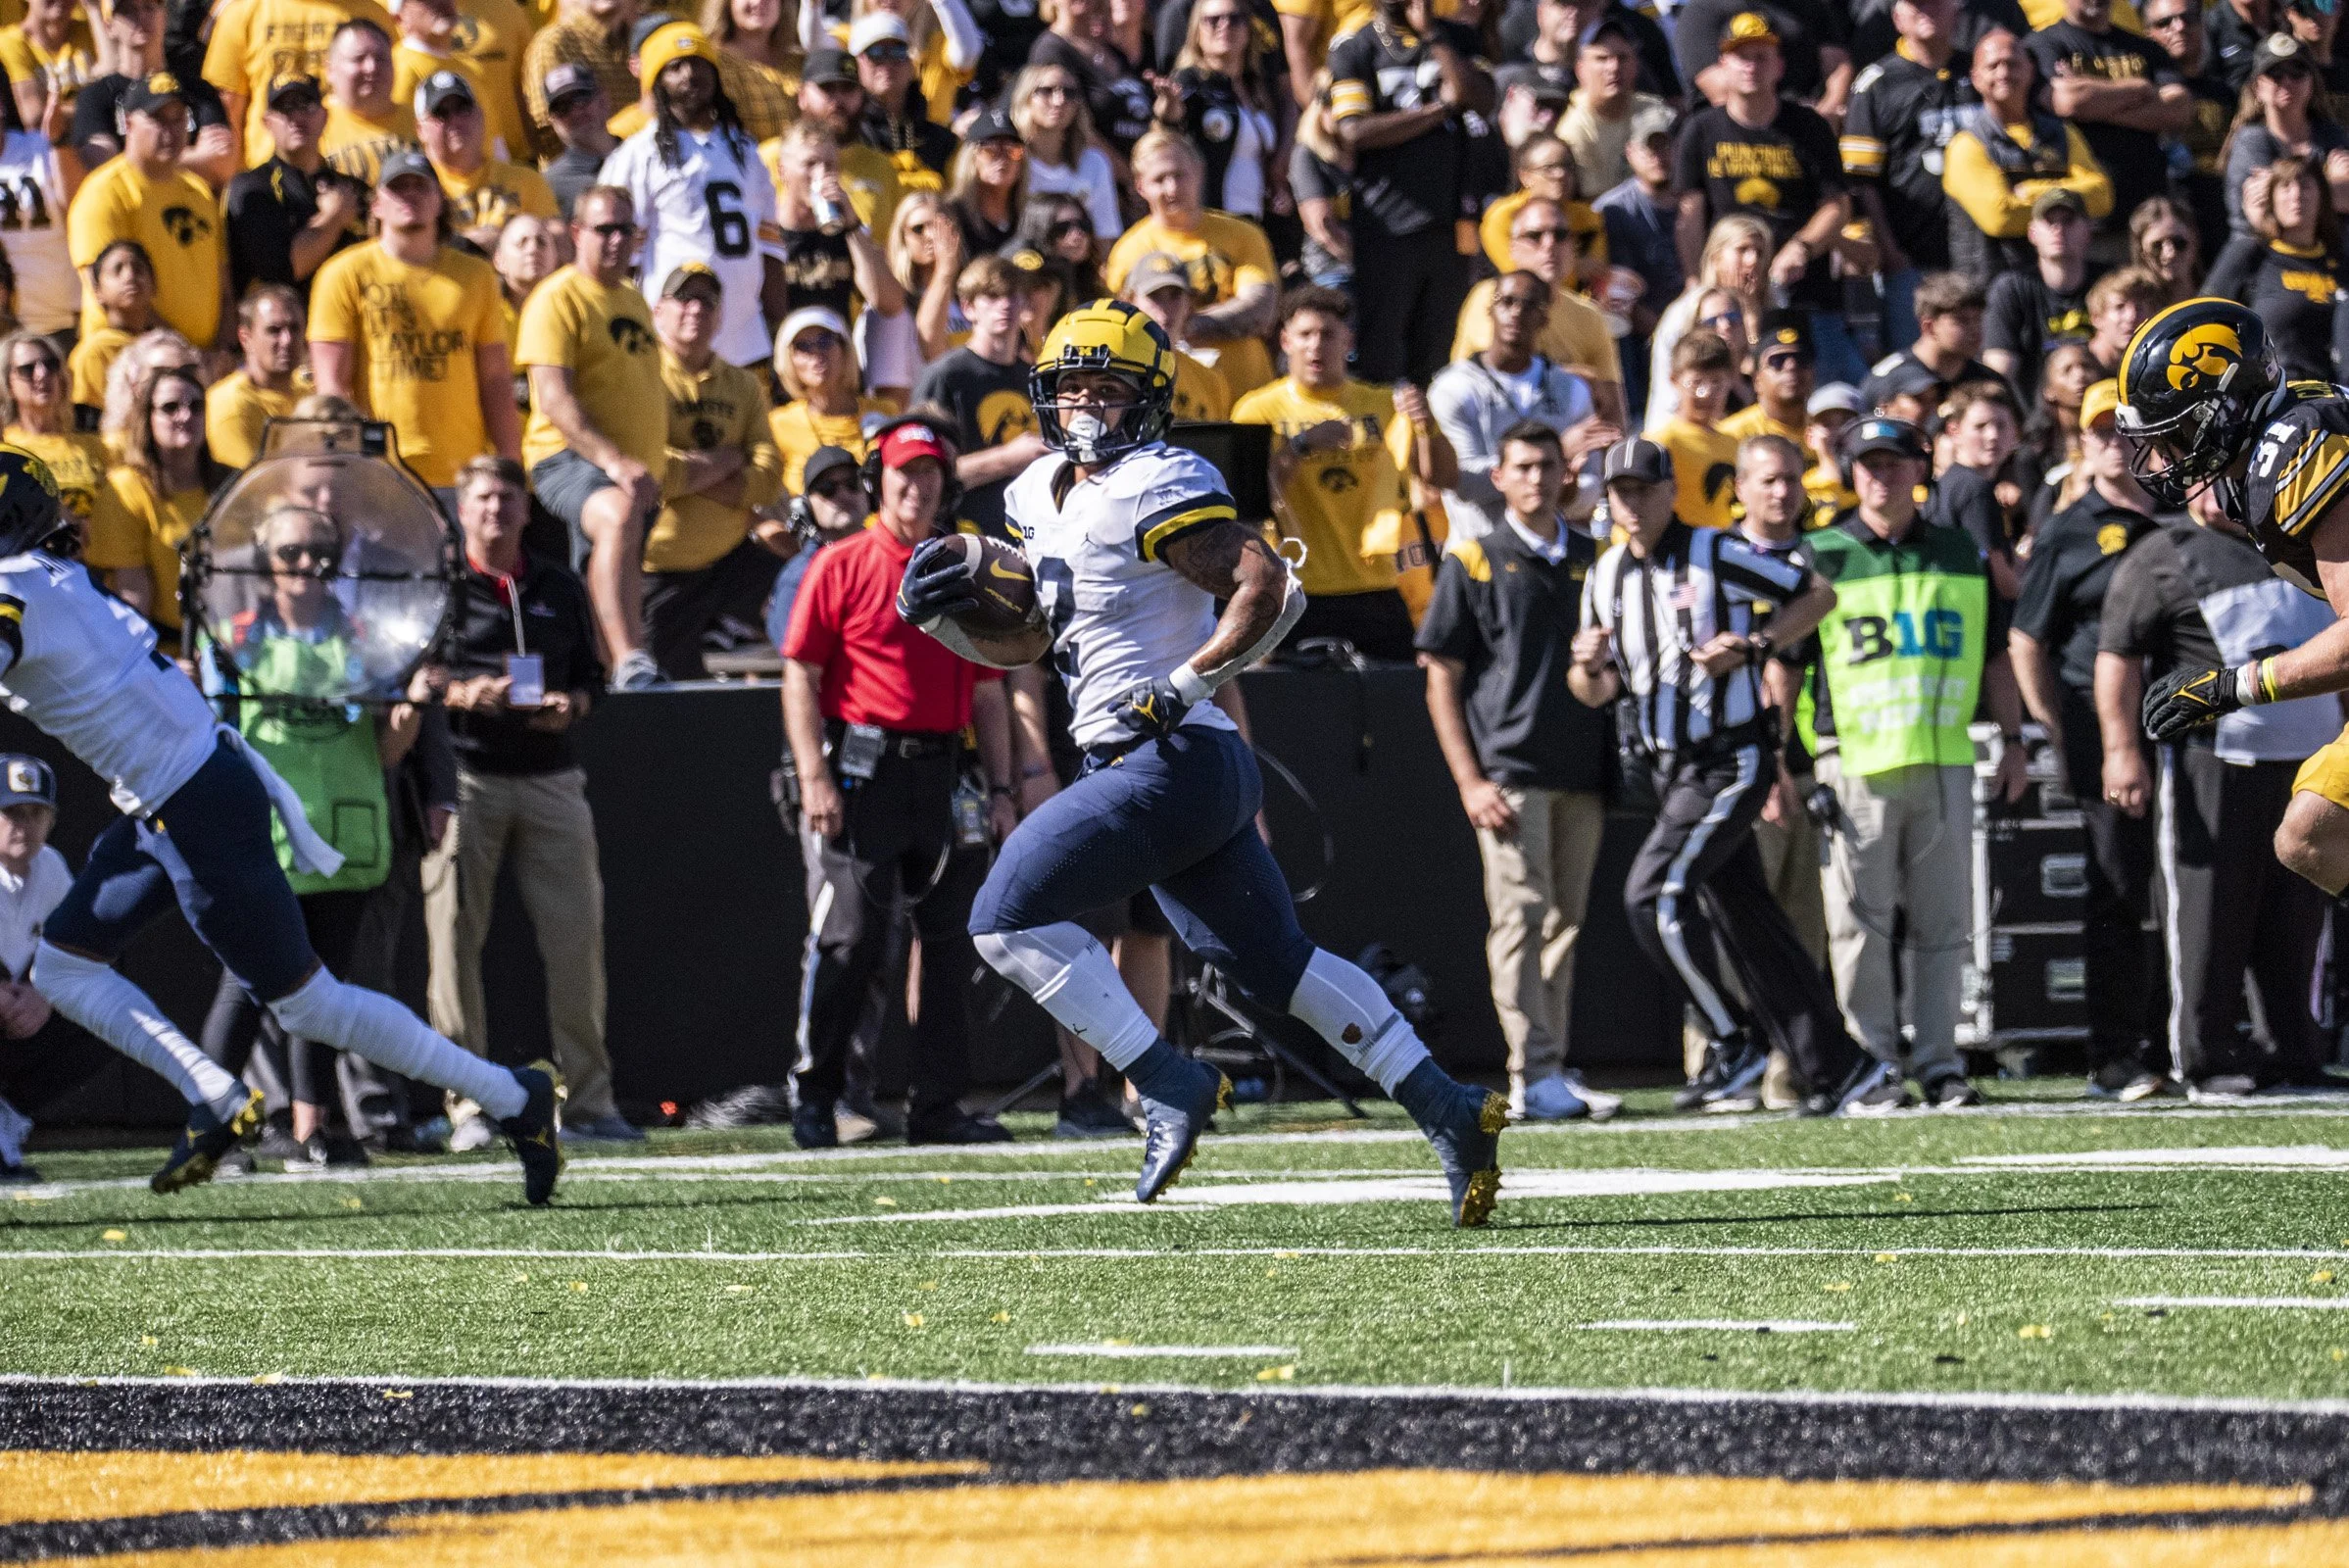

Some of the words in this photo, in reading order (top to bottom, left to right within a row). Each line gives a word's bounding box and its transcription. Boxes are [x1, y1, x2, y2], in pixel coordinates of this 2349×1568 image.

[705, 180, 750, 258] 6
[1022, 525, 1035, 539] 1G
[1843, 608, 1964, 665] B1G
